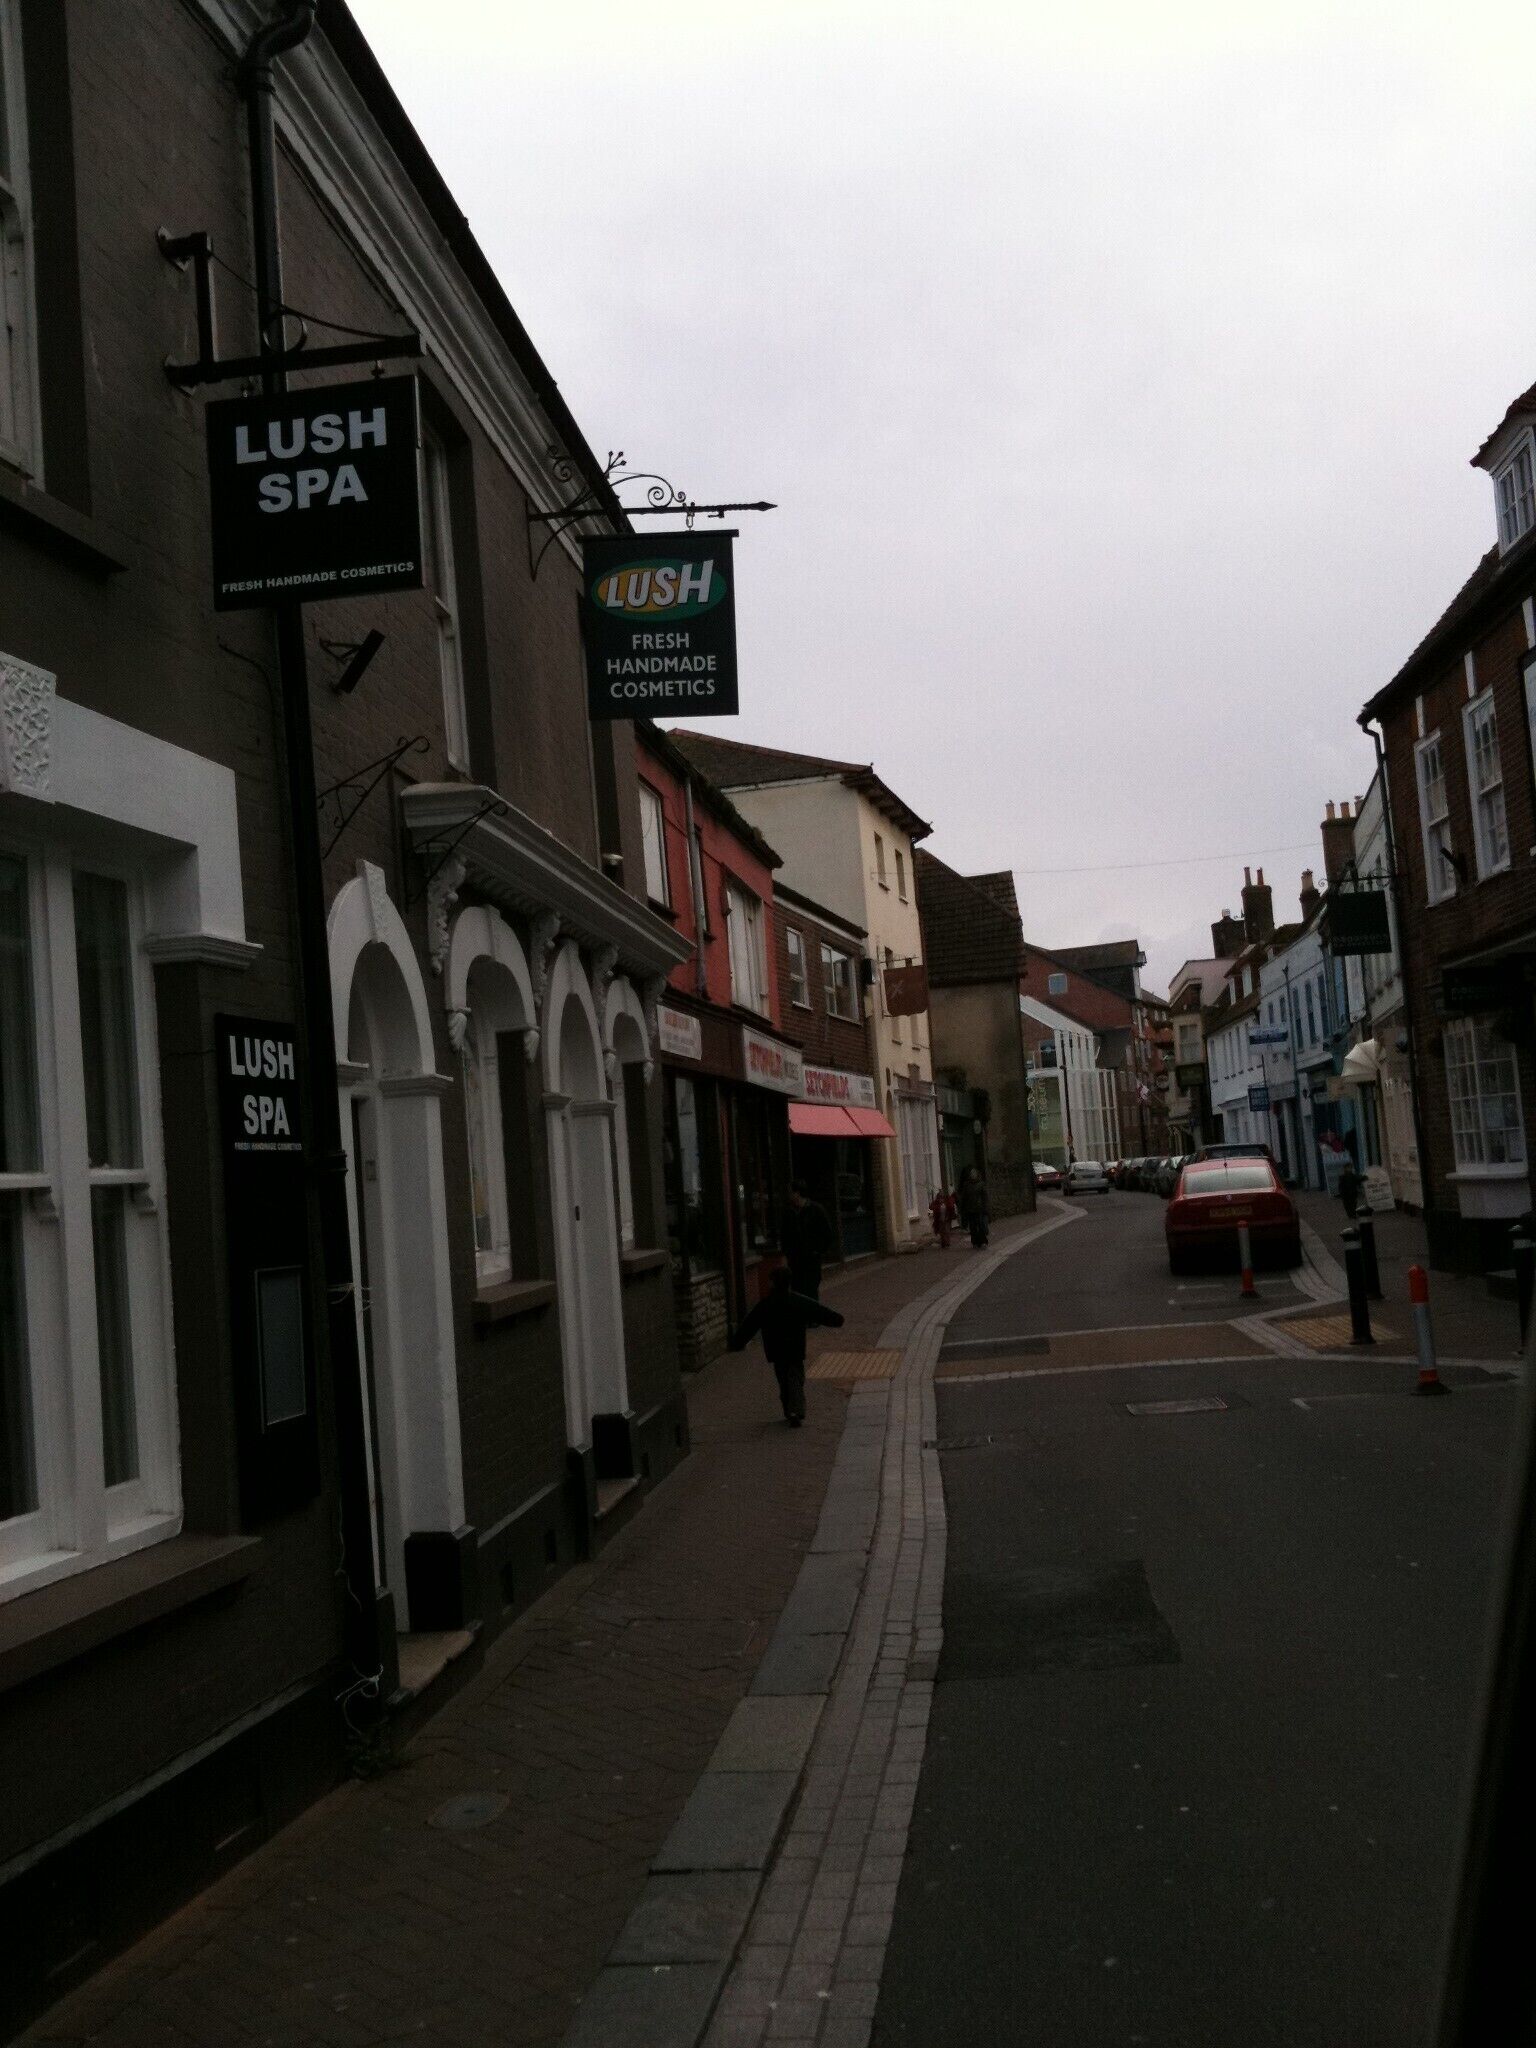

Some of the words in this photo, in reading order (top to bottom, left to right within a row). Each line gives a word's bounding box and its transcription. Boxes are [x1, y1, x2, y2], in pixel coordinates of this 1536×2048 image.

[235, 407, 388, 464] LUSH
[257, 464, 369, 514] SPA
[221, 580, 263, 593] FRESH
[266, 571, 338, 588] HANDMADE
[340, 561, 415, 579] COSMETICS
[604, 558, 715, 610] LUSH
[631, 632, 690, 650] FRESH
[606, 655, 717, 674] HANDMADE
[609, 678, 716, 699] COSMETICS
[229, 1035, 295, 1080] LUSH
[242, 1094, 291, 1136] SPA
